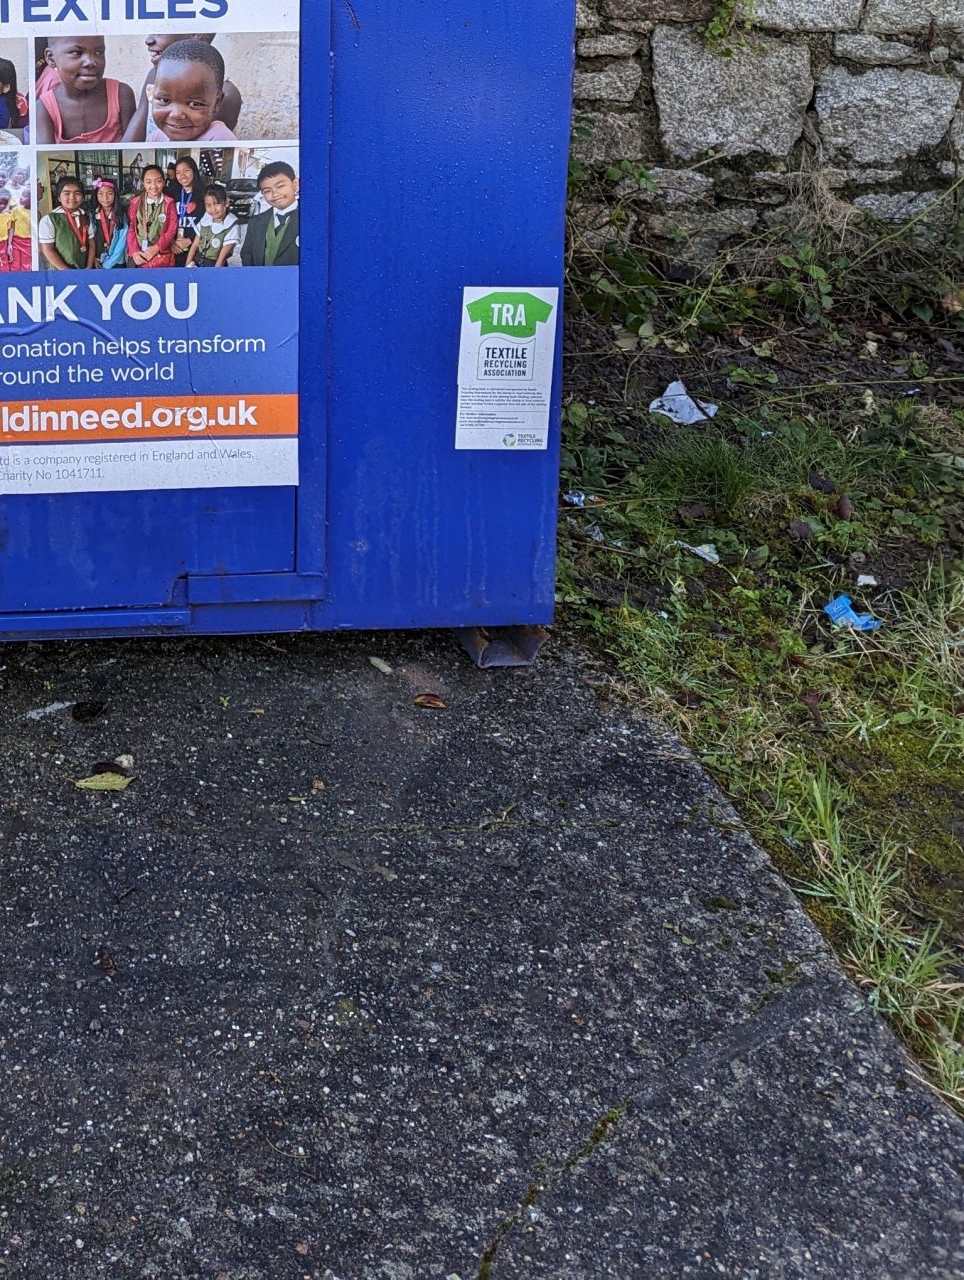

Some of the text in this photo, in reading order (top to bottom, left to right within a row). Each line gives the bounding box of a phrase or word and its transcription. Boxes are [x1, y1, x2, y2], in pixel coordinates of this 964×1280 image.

[88, 283, 198, 320] YOU
[491, 304, 526, 326] TRA
[93, 337, 151, 357] helps
[158, 335, 266, 354] transform
[486, 348, 528, 359] TEXTILE
[68, 364, 103, 382] the
[111, 362, 174, 381] world
[484, 360, 527, 368] RECYCLING
[13, 455, 21, 465] is
[33, 455, 81, 466] company
[85, 451, 136, 464] registered
[140, 451, 149, 462] in
[153, 450, 194, 462] England
[197, 450, 217, 460] and
[36, 471, 51, 480] No
[56, 468, 105, 480] 1041711.
